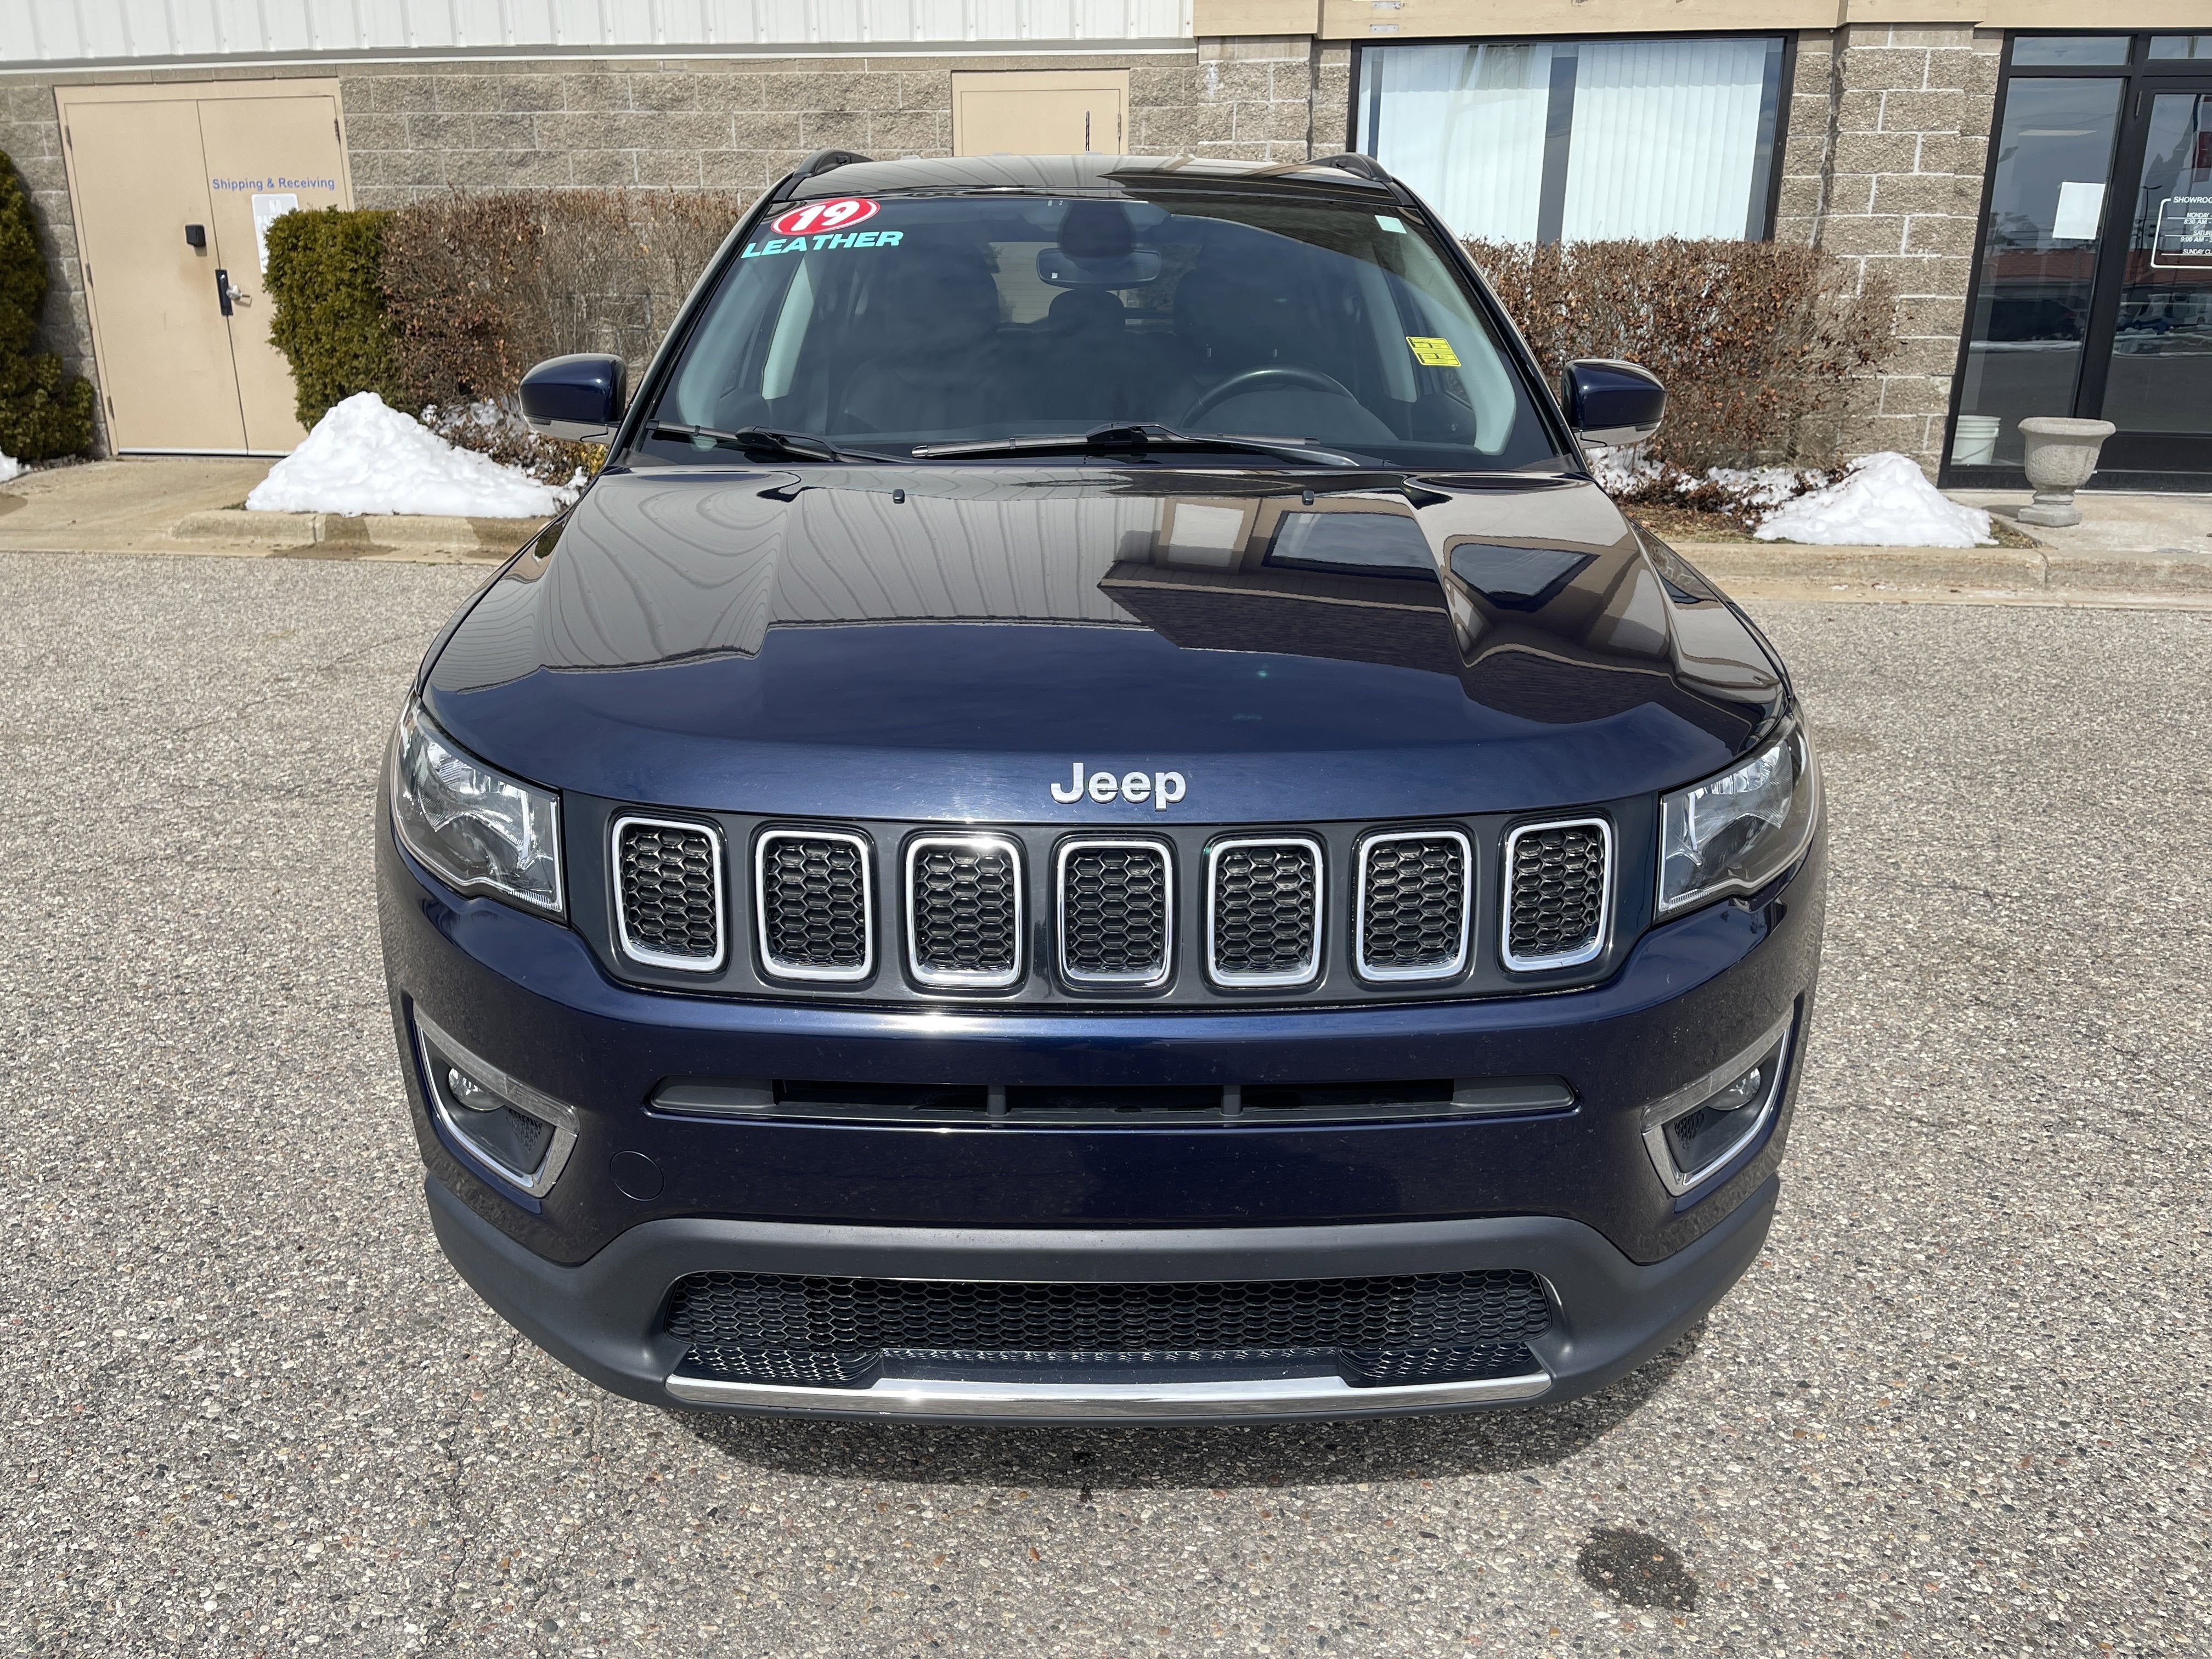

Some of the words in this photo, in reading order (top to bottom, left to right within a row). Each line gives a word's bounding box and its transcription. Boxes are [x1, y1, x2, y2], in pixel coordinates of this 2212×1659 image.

[212, 178, 263, 191] Shipping
[267, 177, 274, 188] &
[278, 177, 335, 190] Receiving
[791, 201, 860, 231] 19
[741, 231, 904, 258] LEATHER
[1050, 762, 1186, 812] Jeep
